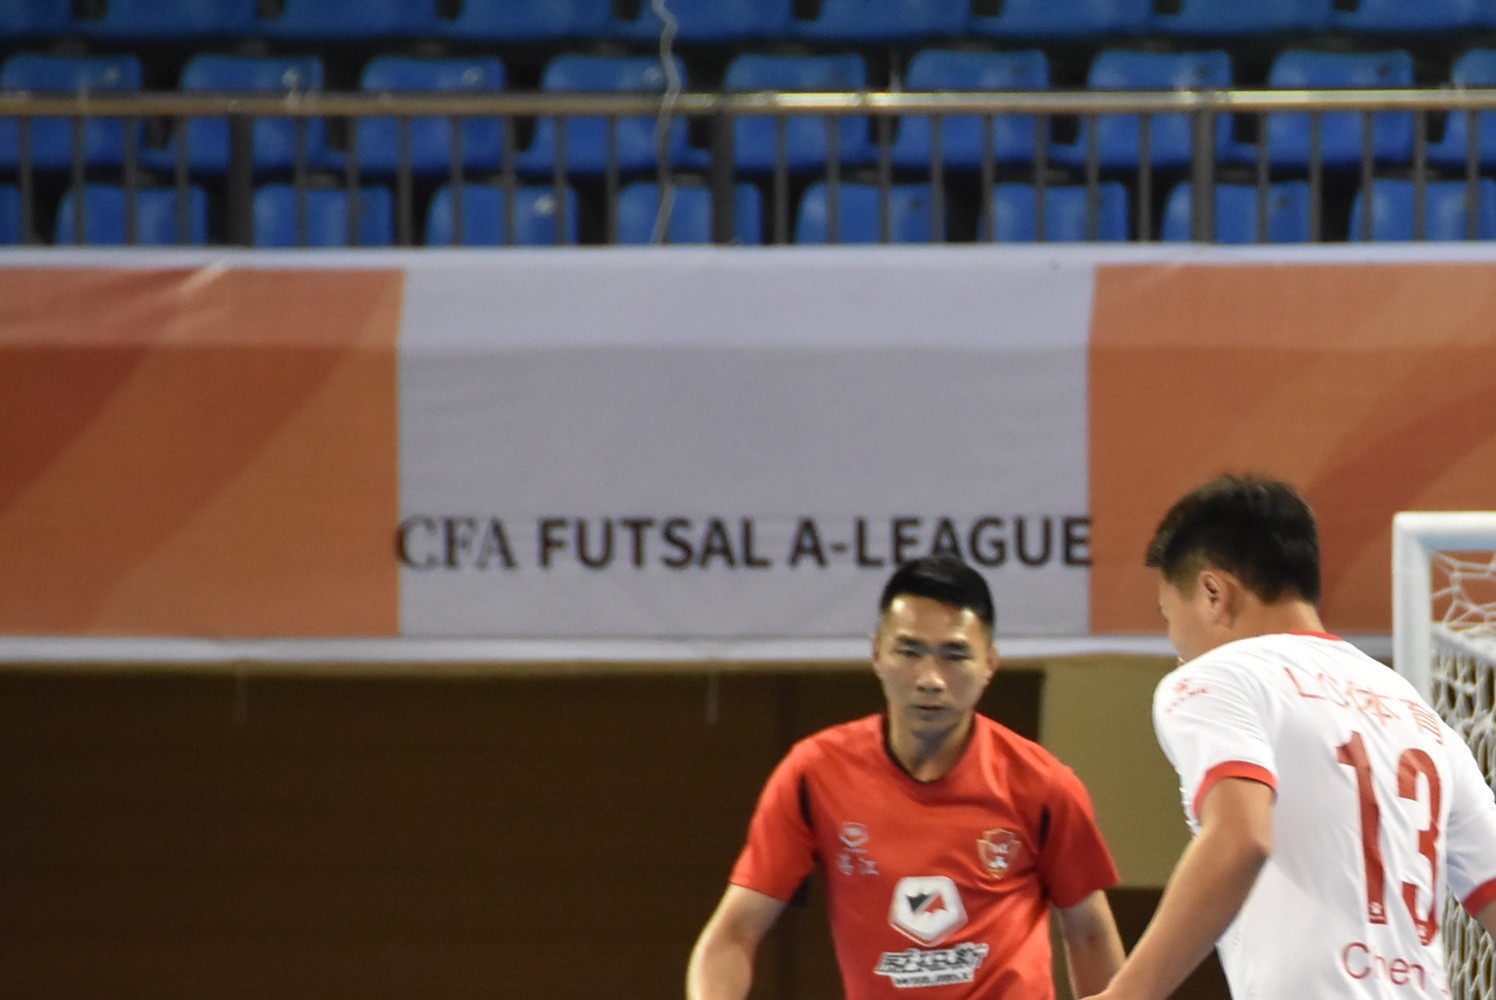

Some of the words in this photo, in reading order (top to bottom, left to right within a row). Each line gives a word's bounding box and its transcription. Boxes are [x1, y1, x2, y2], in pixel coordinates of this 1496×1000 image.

[396, 514, 518, 569] CFA
[538, 516, 770, 569] FUTSAL
[789, 515, 1093, 570] A-LEAGUE
[1336, 730, 1442, 946] 13
